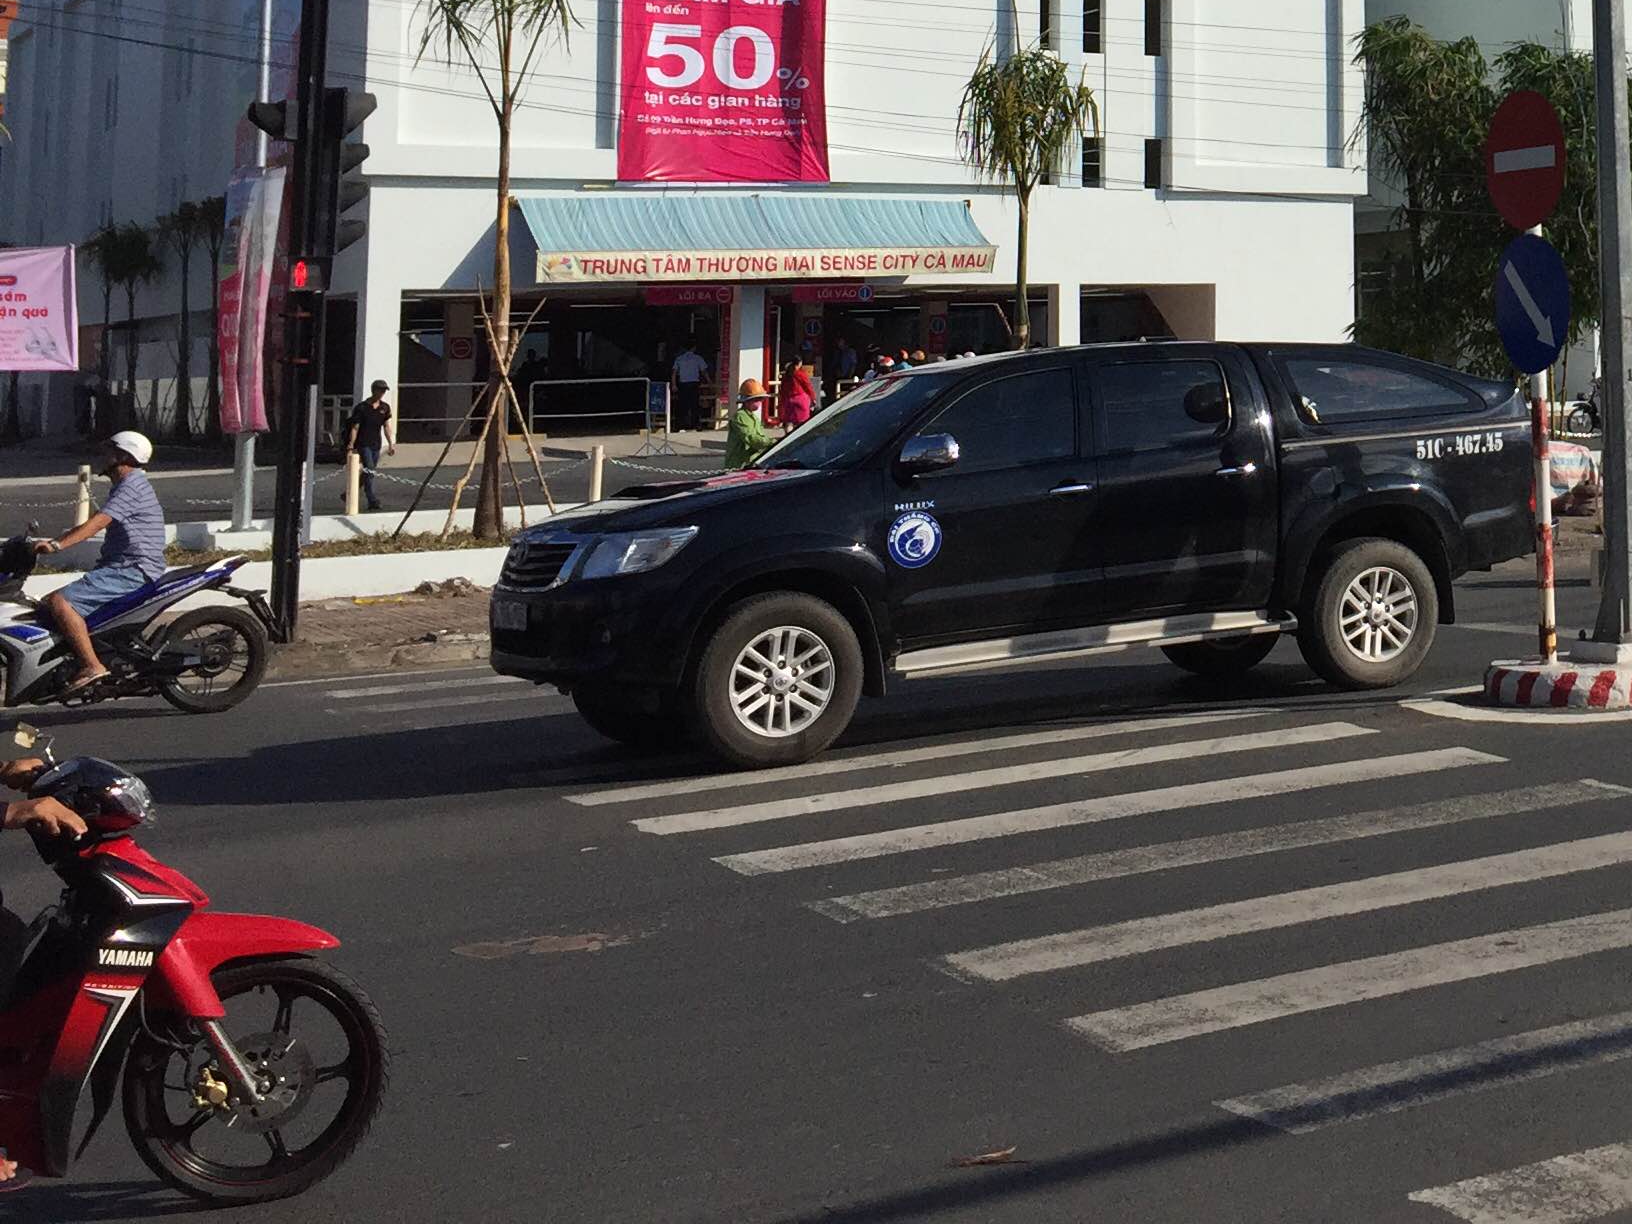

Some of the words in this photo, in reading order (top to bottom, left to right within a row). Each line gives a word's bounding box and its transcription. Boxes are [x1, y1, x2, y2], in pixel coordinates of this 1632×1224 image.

[644, 91, 664, 108] tại
[668, 92, 703, 106] các
[707, 94, 749, 110] gian
[754, 93, 801, 110] hàng
[580, 257, 648, 275] TRUNG
[652, 254, 692, 274] TÂM
[696, 256, 779, 274] THƯƠNG
[820, 253, 877, 271] SENSE
[882, 250, 919, 270] CITY
[923, 250, 947, 269] CÀ
[951, 253, 988, 269] MAU
[895, 500, 934, 511] HILUX
[99, 949, 153, 967] YAMAHA
